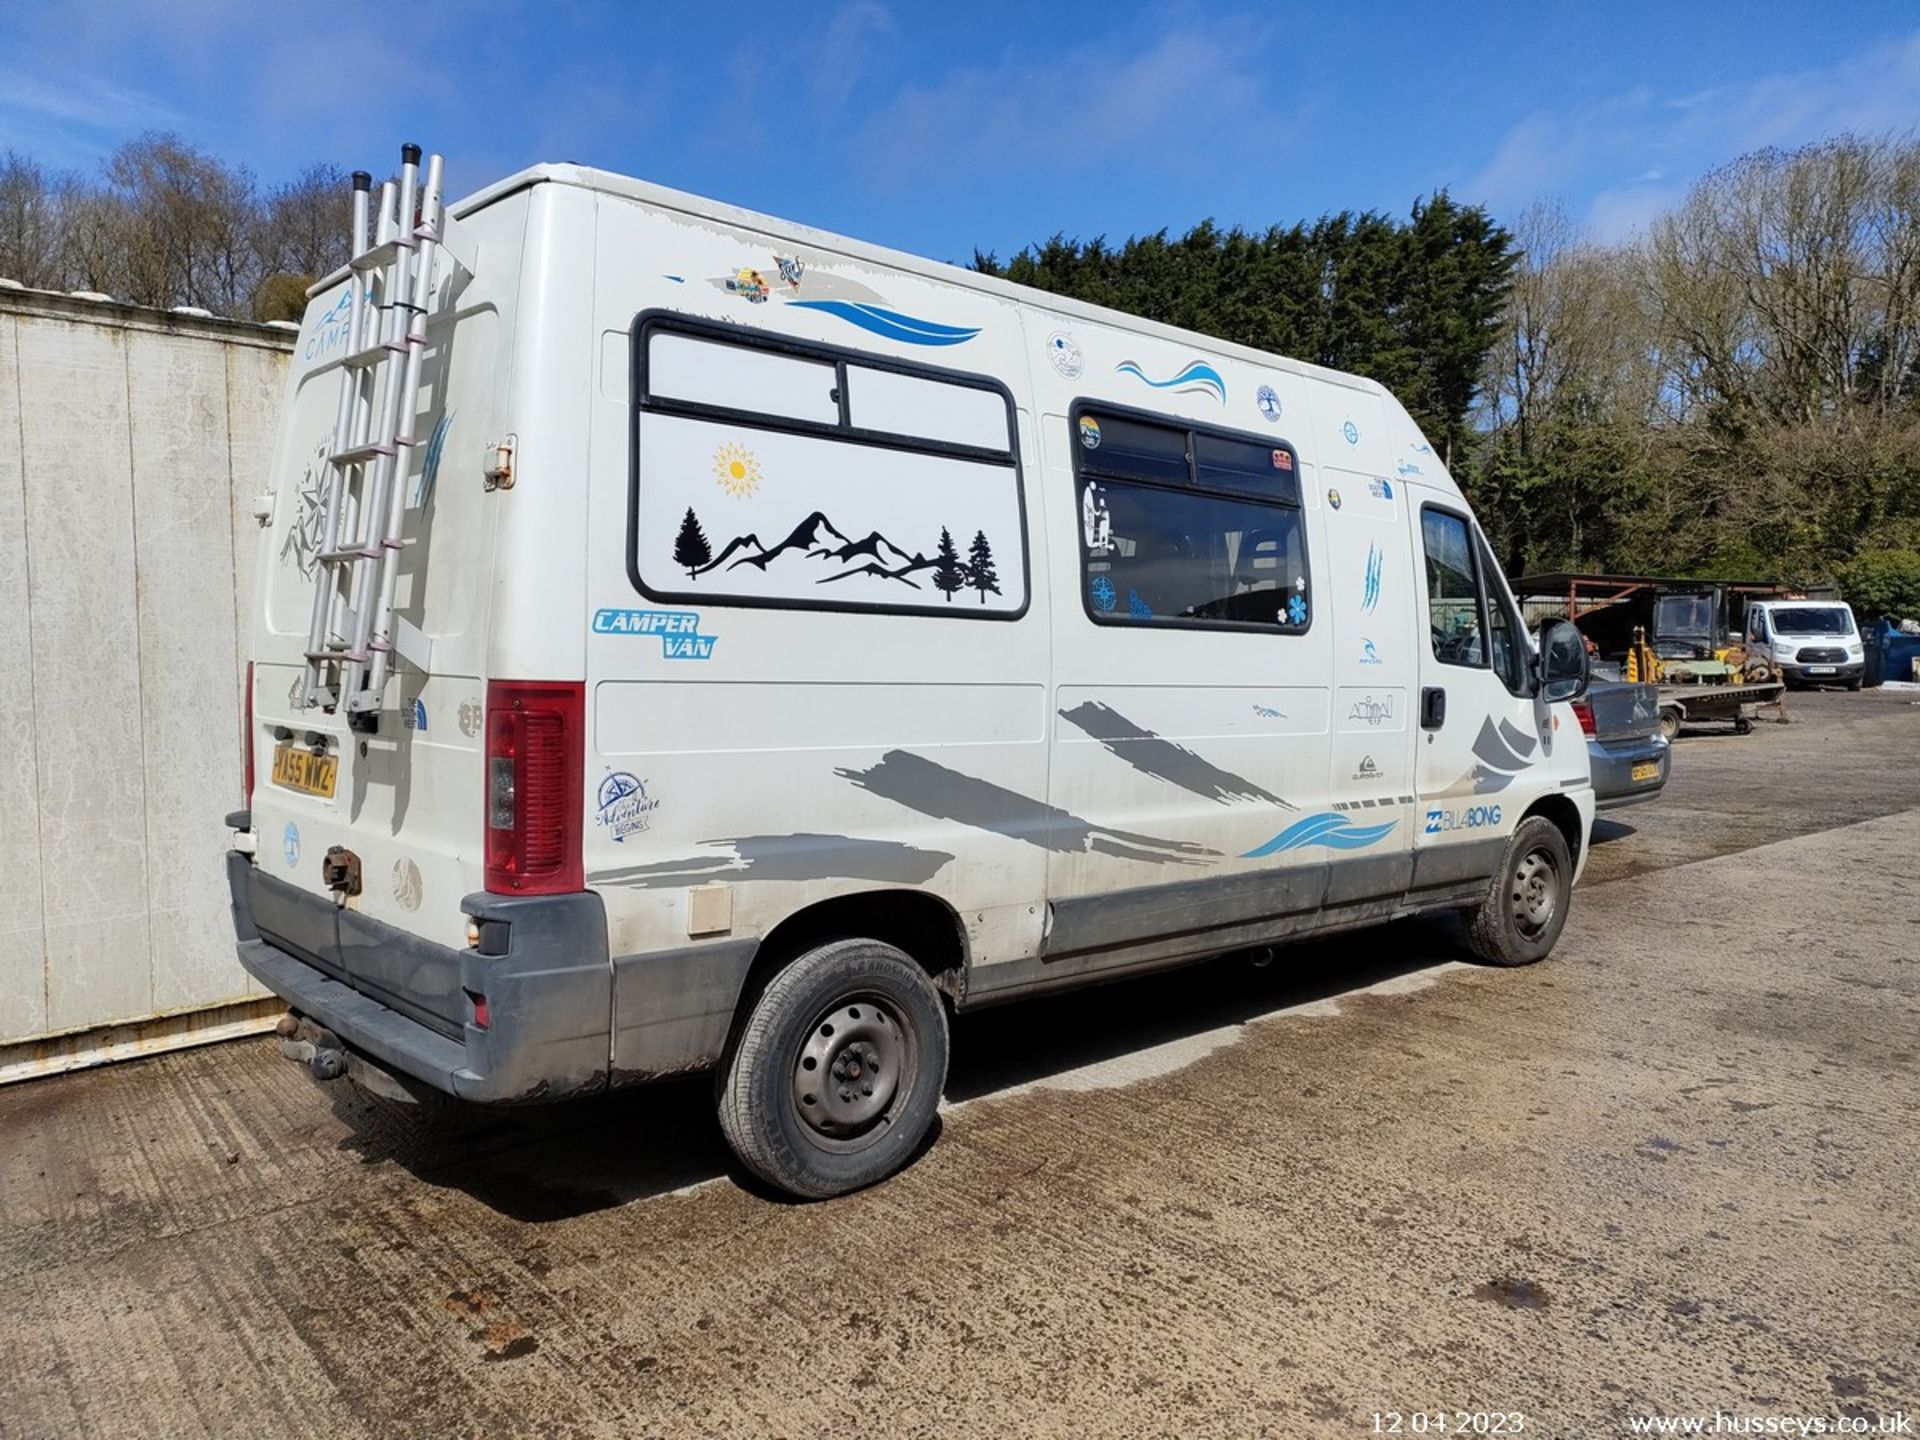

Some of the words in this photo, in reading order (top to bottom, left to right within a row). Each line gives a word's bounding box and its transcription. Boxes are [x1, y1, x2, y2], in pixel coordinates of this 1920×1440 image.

[594, 611, 698, 633] CAMPER
[665, 637, 712, 657] VAN
[1442, 804, 1501, 832] BILLABONG
